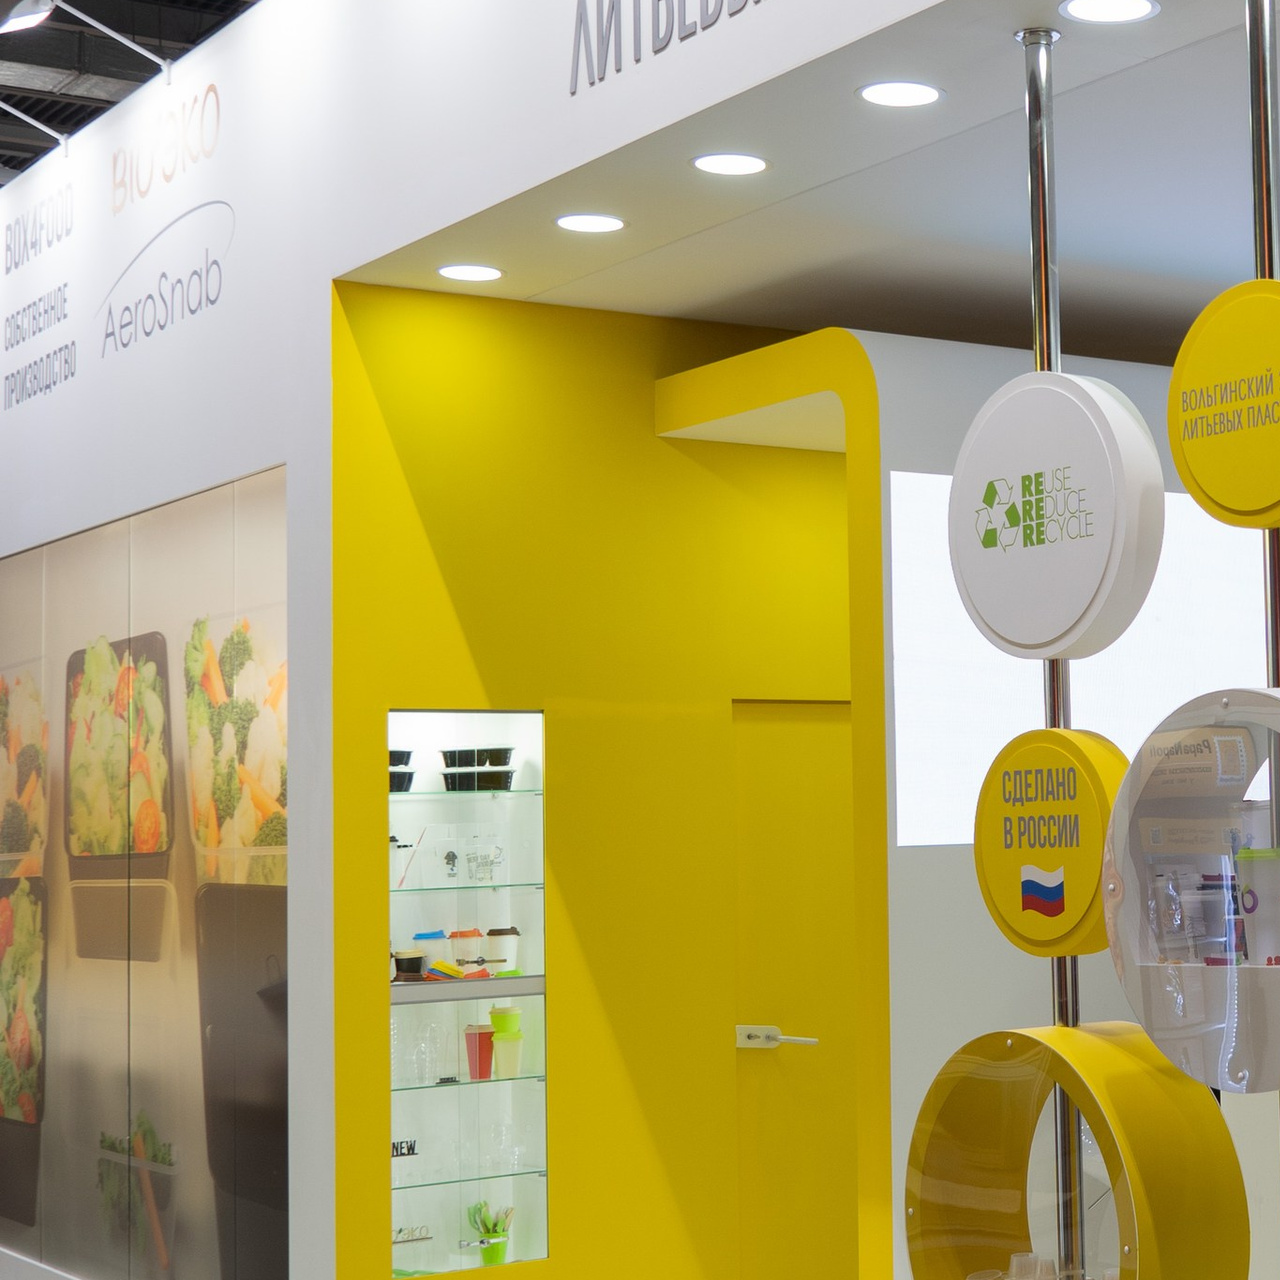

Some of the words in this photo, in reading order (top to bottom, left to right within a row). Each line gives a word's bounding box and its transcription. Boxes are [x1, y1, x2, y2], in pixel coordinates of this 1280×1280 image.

[5, 182, 75, 276] BOX4FOOD
[4, 283, 68, 352] СОБСТВЕННОЕ
[101, 248, 222, 359] AeroSnab
[4, 340, 76, 411] ПРОИЗВОДСТВО
[1182, 367, 1274, 413] ВОЛЬГИНСКИЙ
[1182, 409, 1243, 442] ЛИТЬЕВЫХ
[1021, 466, 1071, 499] REUSE
[1022, 489, 1087, 524] REDUCE
[1022, 512, 1095, 548] RECYCLE
[1002, 767, 1077, 807] СДЕЛАНО
[1003, 816, 1014, 849] В
[1017, 814, 1080, 849] РОССИИ
[391, 1140, 417, 1156] NEW
